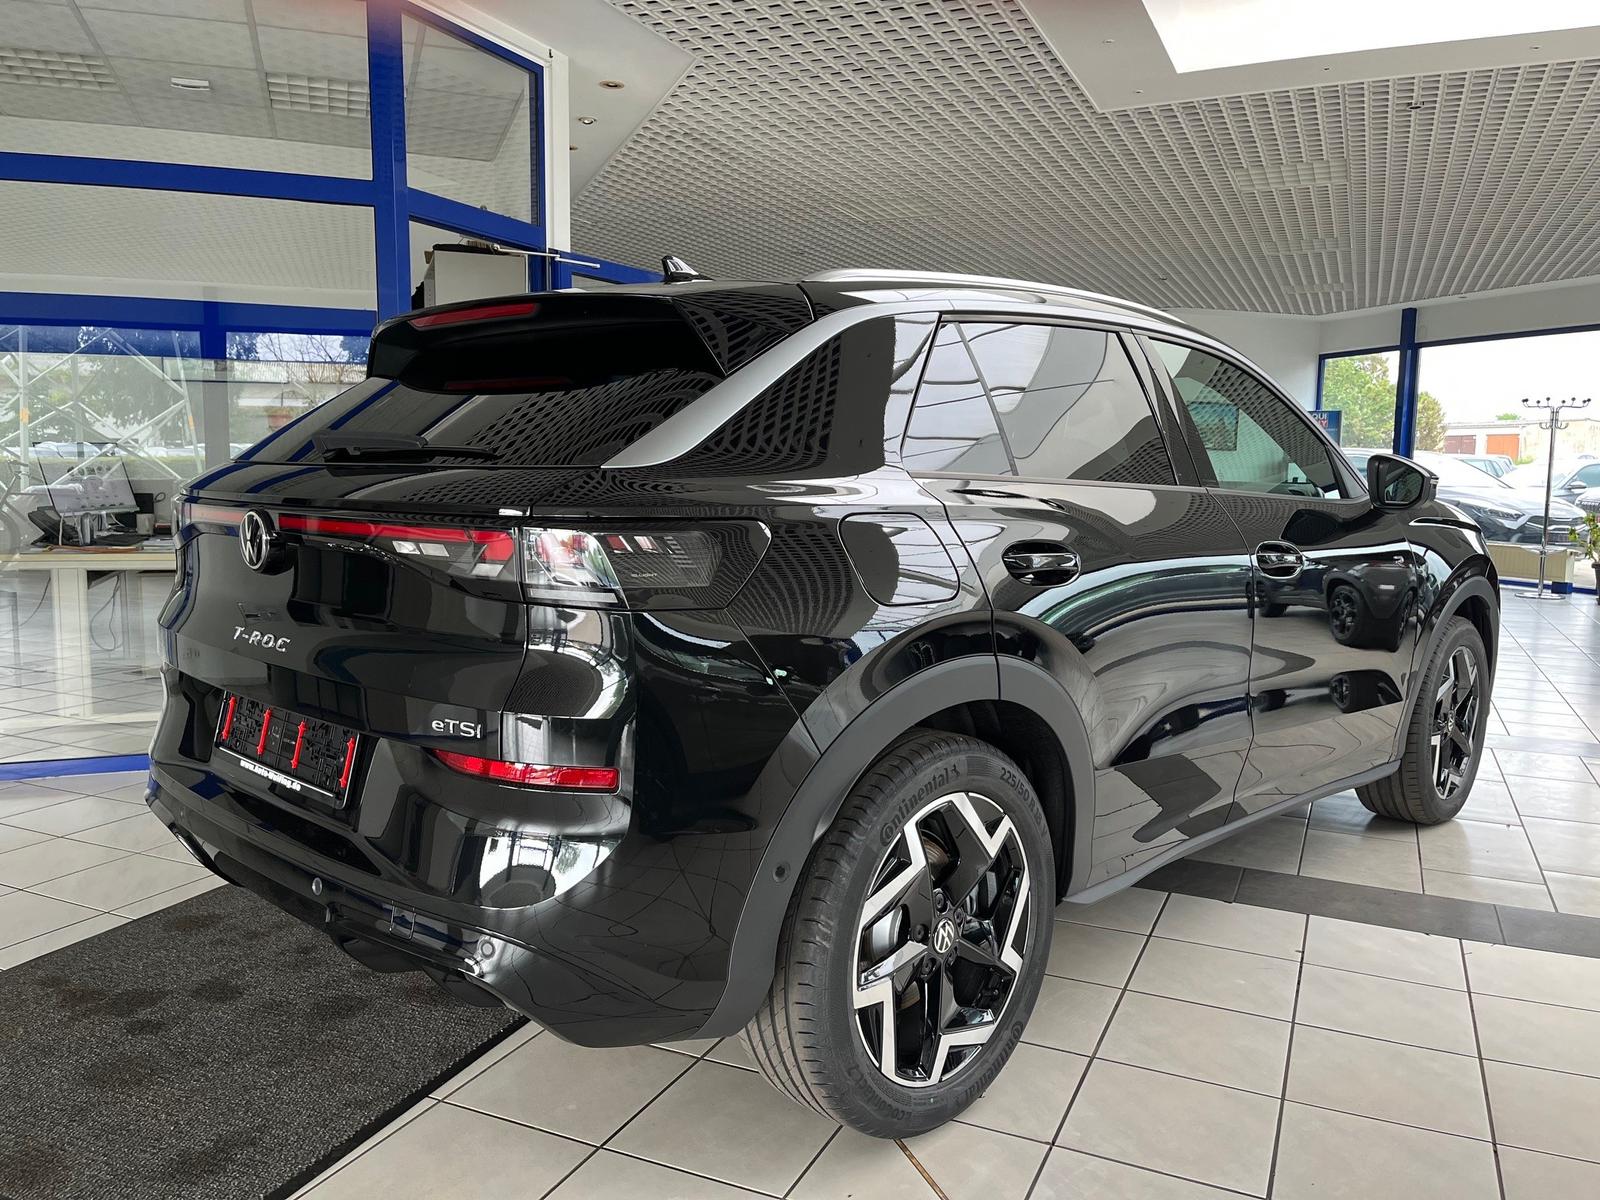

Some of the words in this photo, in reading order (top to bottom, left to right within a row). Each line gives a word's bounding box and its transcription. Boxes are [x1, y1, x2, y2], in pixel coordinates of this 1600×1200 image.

[233, 626, 291, 652] T-ROC
[431, 718, 481, 739] eTSI
[1000, 767, 1030, 801] 225/50
[880, 767, 949, 846] Continental
